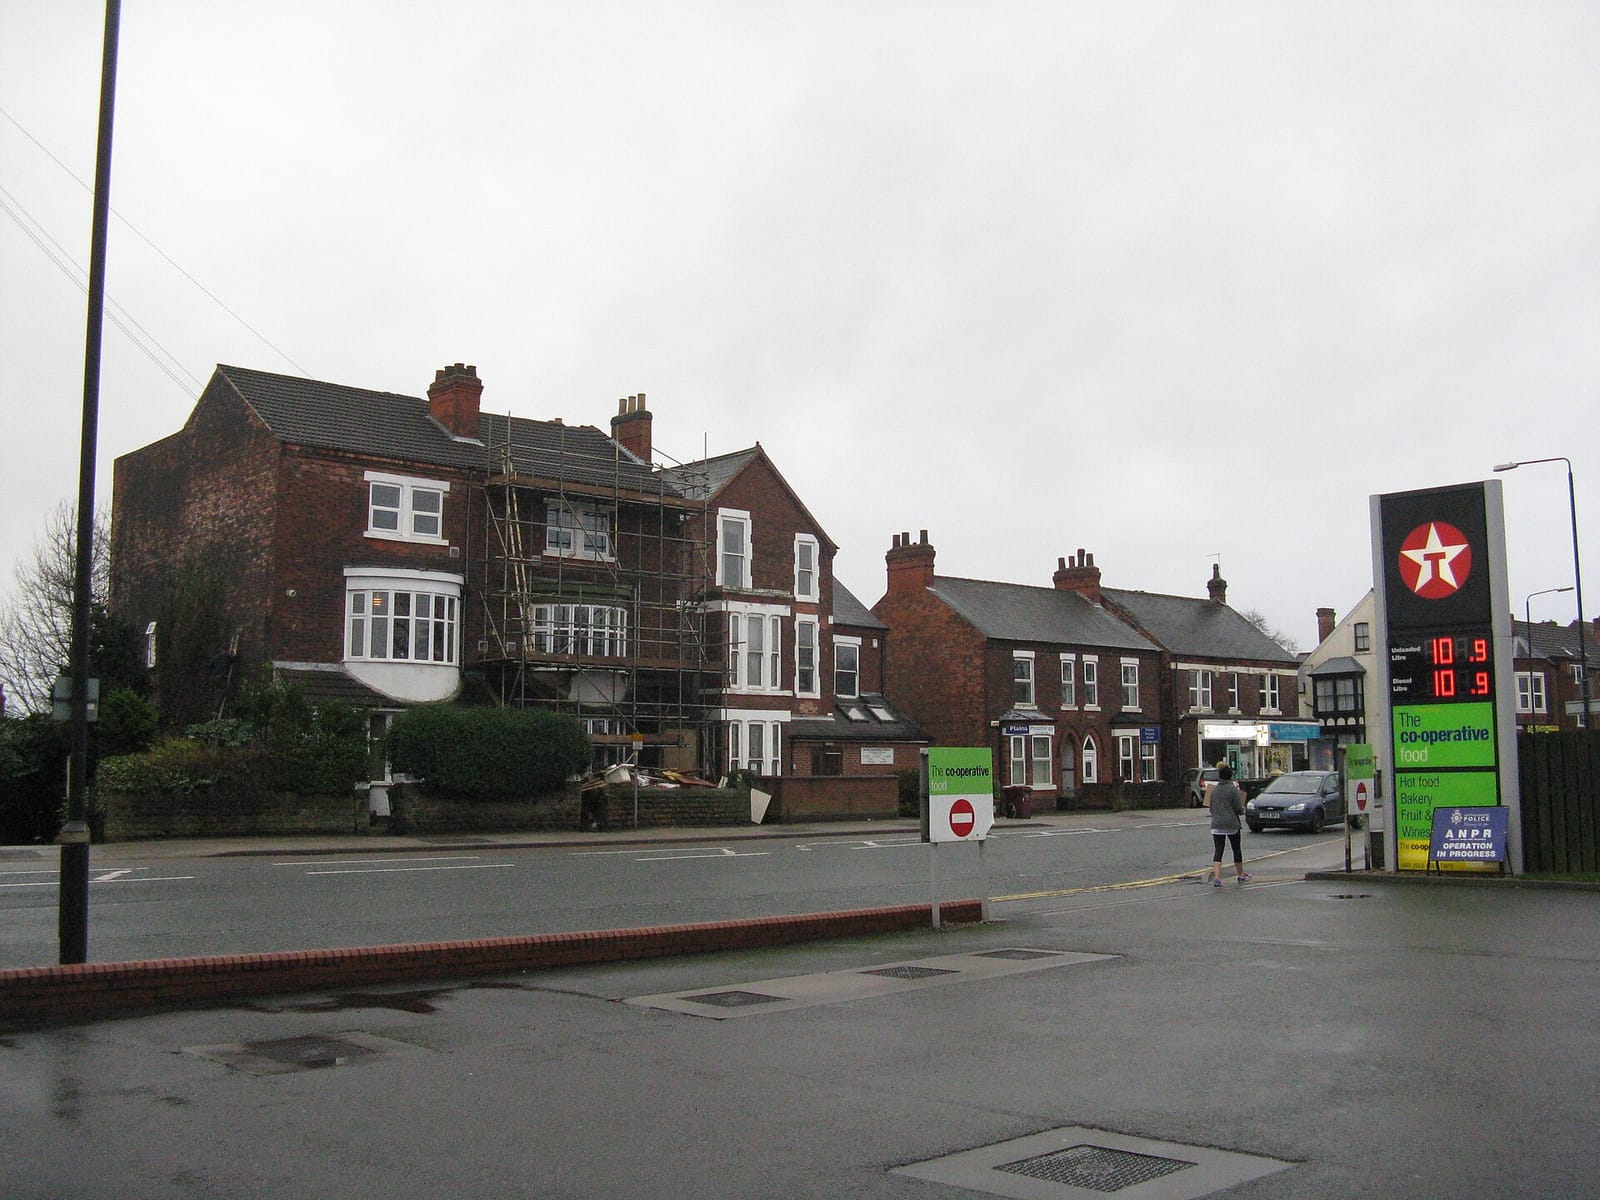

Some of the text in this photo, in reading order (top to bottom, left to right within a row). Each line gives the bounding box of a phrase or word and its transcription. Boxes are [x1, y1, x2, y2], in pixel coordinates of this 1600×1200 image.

[1398, 712, 1421, 728] The
[1401, 726, 1489, 745] co-operative
[1400, 747, 1429, 763] food
[931, 764, 990, 779] The co-operative
[931, 779, 948, 792] food
[1400, 776, 1440, 788] Hot food
[1401, 793, 1432, 806] Bakery
[1401, 809, 1432, 821] Fruit &
[1402, 827, 1431, 838] Wines
[1411, 843, 1430, 852] co-op
[1442, 842, 1493, 850] OPERATION
[1436, 850, 1496, 858] IN PROGRESS
